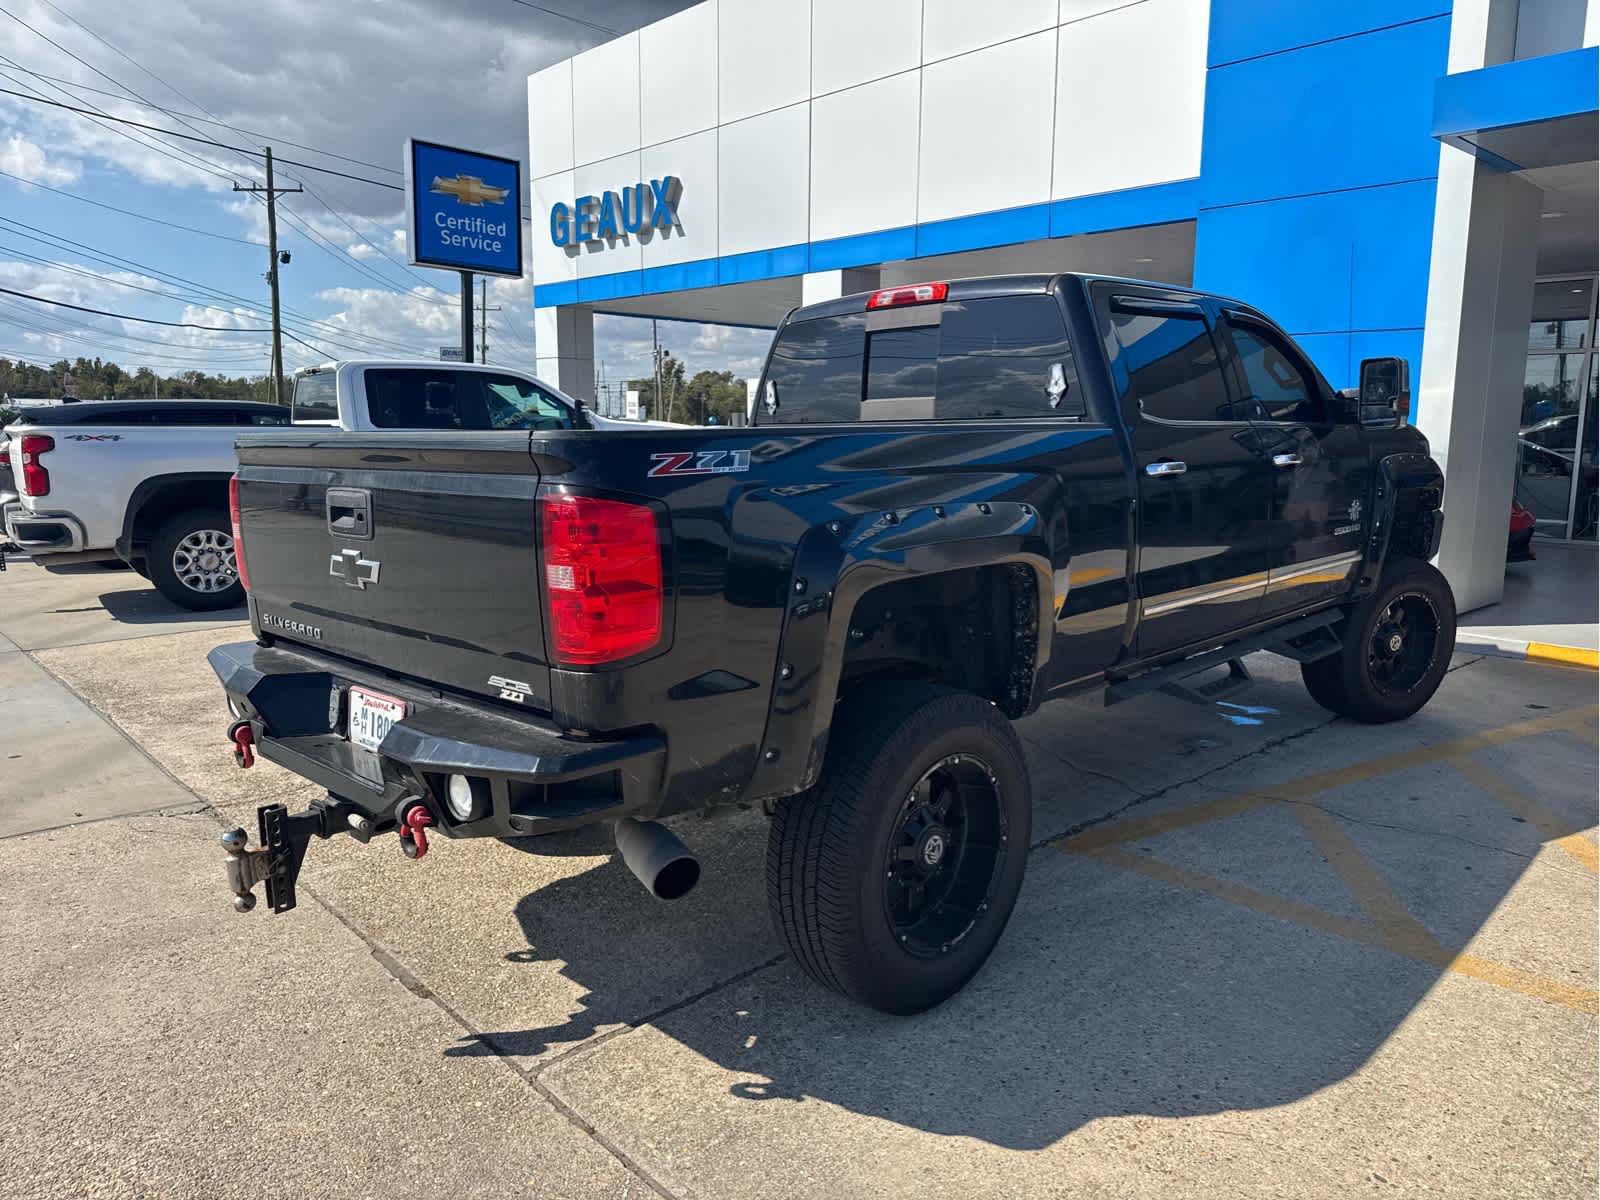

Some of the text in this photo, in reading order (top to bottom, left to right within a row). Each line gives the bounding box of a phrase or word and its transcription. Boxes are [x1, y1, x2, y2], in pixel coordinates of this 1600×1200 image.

[550, 176, 681, 247] GEAUX
[435, 212, 506, 237] Certified
[441, 230, 501, 252] Service
[648, 449, 751, 477] Z71
[263, 614, 321, 639] SILVERADO
